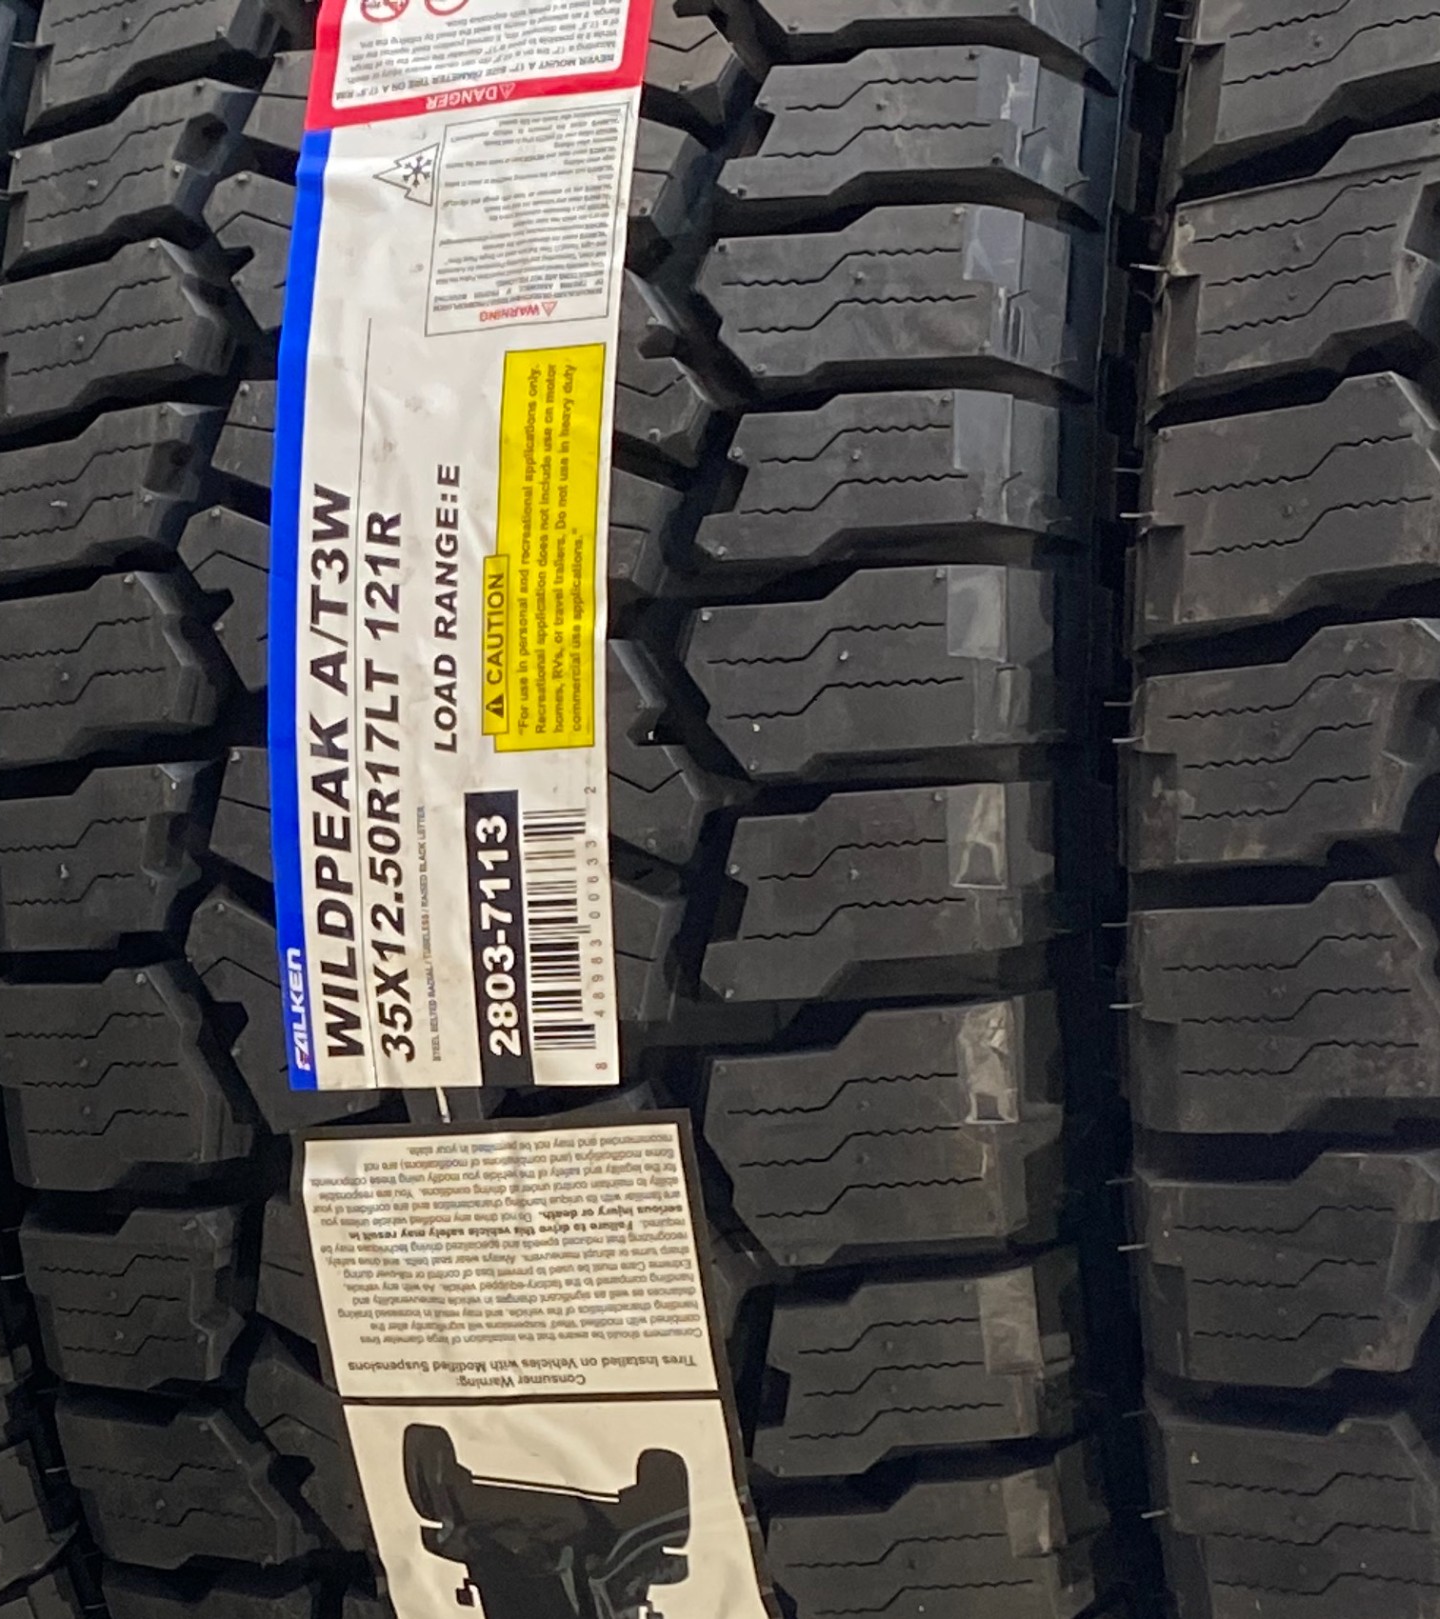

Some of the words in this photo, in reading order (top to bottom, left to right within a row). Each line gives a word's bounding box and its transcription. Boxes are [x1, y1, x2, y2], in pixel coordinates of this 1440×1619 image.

[381, 84, 389, 93] A
[391, 81, 405, 91] ON
[426, 84, 498, 110] DANGER
[479, 303, 540, 323] WARNING
[527, 364, 541, 396] only.
[544, 363, 557, 402] motor
[561, 364, 577, 393] duty
[544, 407, 554, 423] on
[559, 398, 575, 436] heavy
[522, 401, 538, 481] applications
[542, 427, 553, 452] use
[559, 440, 570, 453] in
[538, 456, 552, 505] include
[558, 457, 570, 481] use
[556, 485, 568, 507] not
[518, 492, 534, 564] recreational
[538, 508, 550, 530] not
[555, 511, 567, 529] Do
[434, 463, 460, 641] RANGE:E
[536, 534, 549, 566] does
[552, 535, 566, 584] trailers.
[364, 511, 402, 642] 121R
[517, 568, 530, 593] and
[310, 483, 351, 697] A/T3W
[532, 570, 550, 645] application
[552, 588, 564, 625] travel
[486, 573, 505, 684] CAUTION
[516, 597, 532, 656] personal
[553, 630, 563, 643] or
[569, 624, 582, 648] use
[517, 660, 528, 673] in
[551, 647, 565, 679] RVs,
[518, 678, 529, 701] use
[529, 648, 549, 733] Recreational
[566, 652, 584, 731] commercial
[434, 653, 458, 753] LOAD
[550, 683, 567, 733] homes,
[415, 805, 426, 839] LETTER
[364, 657, 416, 1063] 35X12.50R17LT
[417, 842, 426, 871] BLACK
[310, 709, 365, 1058] WILDPEAK
[476, 814, 522, 1058] 2803-7113
[287, 946, 311, 1073] FALKEN
[538, 1209, 578, 1220] death.
[596, 1204, 633, 1217] injury
[636, 1204, 682, 1214] serious
[347, 1231, 360, 1240] in
[362, 1230, 397, 1240] result
[399, 1227, 425, 1236] may
[427, 1225, 465, 1237] safely
[467, 1226, 511, 1237] vehicle
[513, 1225, 535, 1236] this
[537, 1222, 570, 1234] drive
[572, 1222, 586, 1232] to
[588, 1220, 633, 1231] Failure
[346, 1358, 429, 1373] Suspensions
[431, 1359, 486, 1373] Modified
[488, 1359, 518, 1371] with
[519, 1357, 578, 1369] Vehicles
[579, 1357, 597, 1366] on
[600, 1355, 658, 1367] Installed
[661, 1354, 696, 1366] Tires
[454, 1374, 514, 1388] Warning:
[517, 1373, 586, 1386] Consumer
